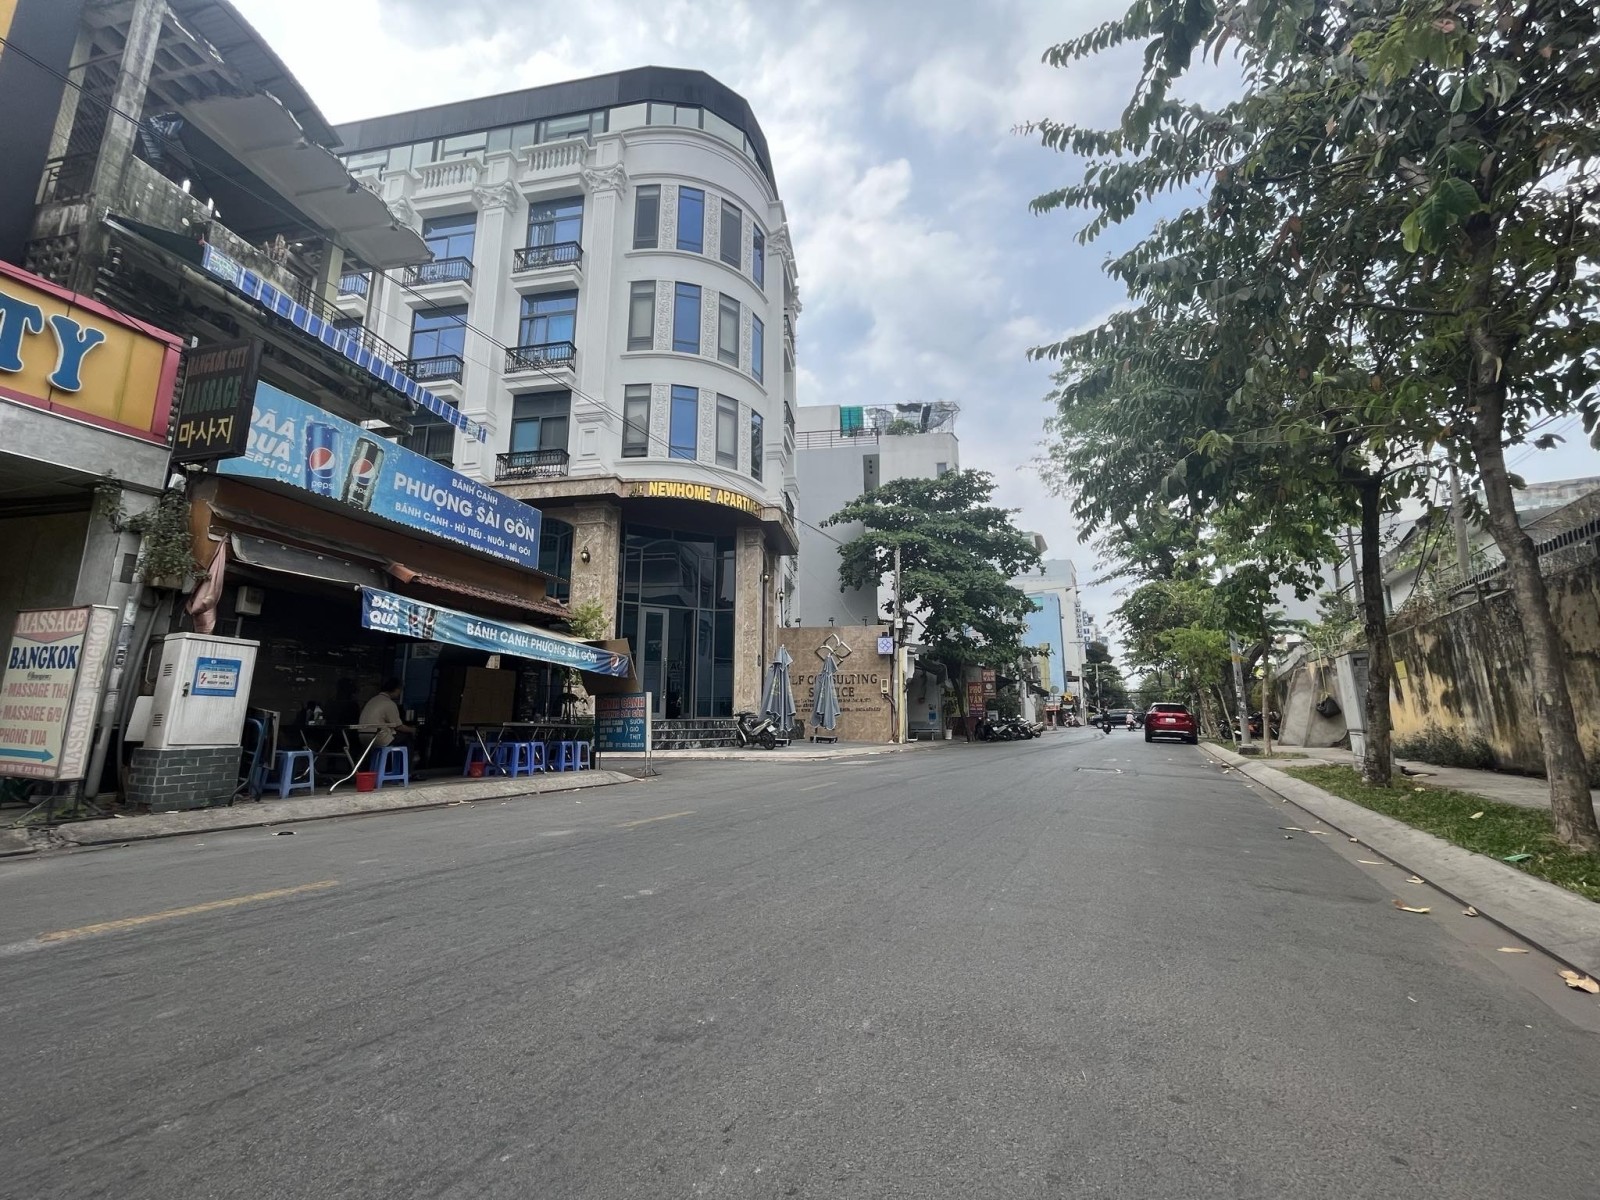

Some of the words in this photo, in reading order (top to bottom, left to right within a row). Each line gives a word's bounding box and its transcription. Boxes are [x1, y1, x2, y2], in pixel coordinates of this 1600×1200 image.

[181, 375, 242, 416] MASSAGE
[178, 415, 234, 449] 마사지
[452, 477, 475, 495] BÁNH
[476, 489, 499, 506] CANH
[648, 481, 711, 501] NEWHOME
[393, 471, 473, 517] PHƯỢNG
[476, 505, 500, 529] SÀI
[504, 517, 535, 542] GÒN
[395, 502, 421, 518] BÁNH
[423, 512, 449, 528] CANH
[518, 545, 531, 557] GÓI
[16, 610, 86, 634] MASSAGE
[466, 621, 498, 641] BÁNH
[499, 630, 529, 648] CANH
[530, 637, 566, 656] PHƯỢNG
[567, 645, 580, 660] SÀI
[8, 645, 80, 670] BANGKOK
[7, 682, 51, 698] MASSAGE
[61, 695, 94, 776] MASSAGE
[81, 612, 111, 690] BANGKOK
[789, 675, 805, 686] LF
[2, 705, 46, 721] MASSAGE
[46, 706, 62, 723] 6/9
[30, 729, 47, 746] VUA
